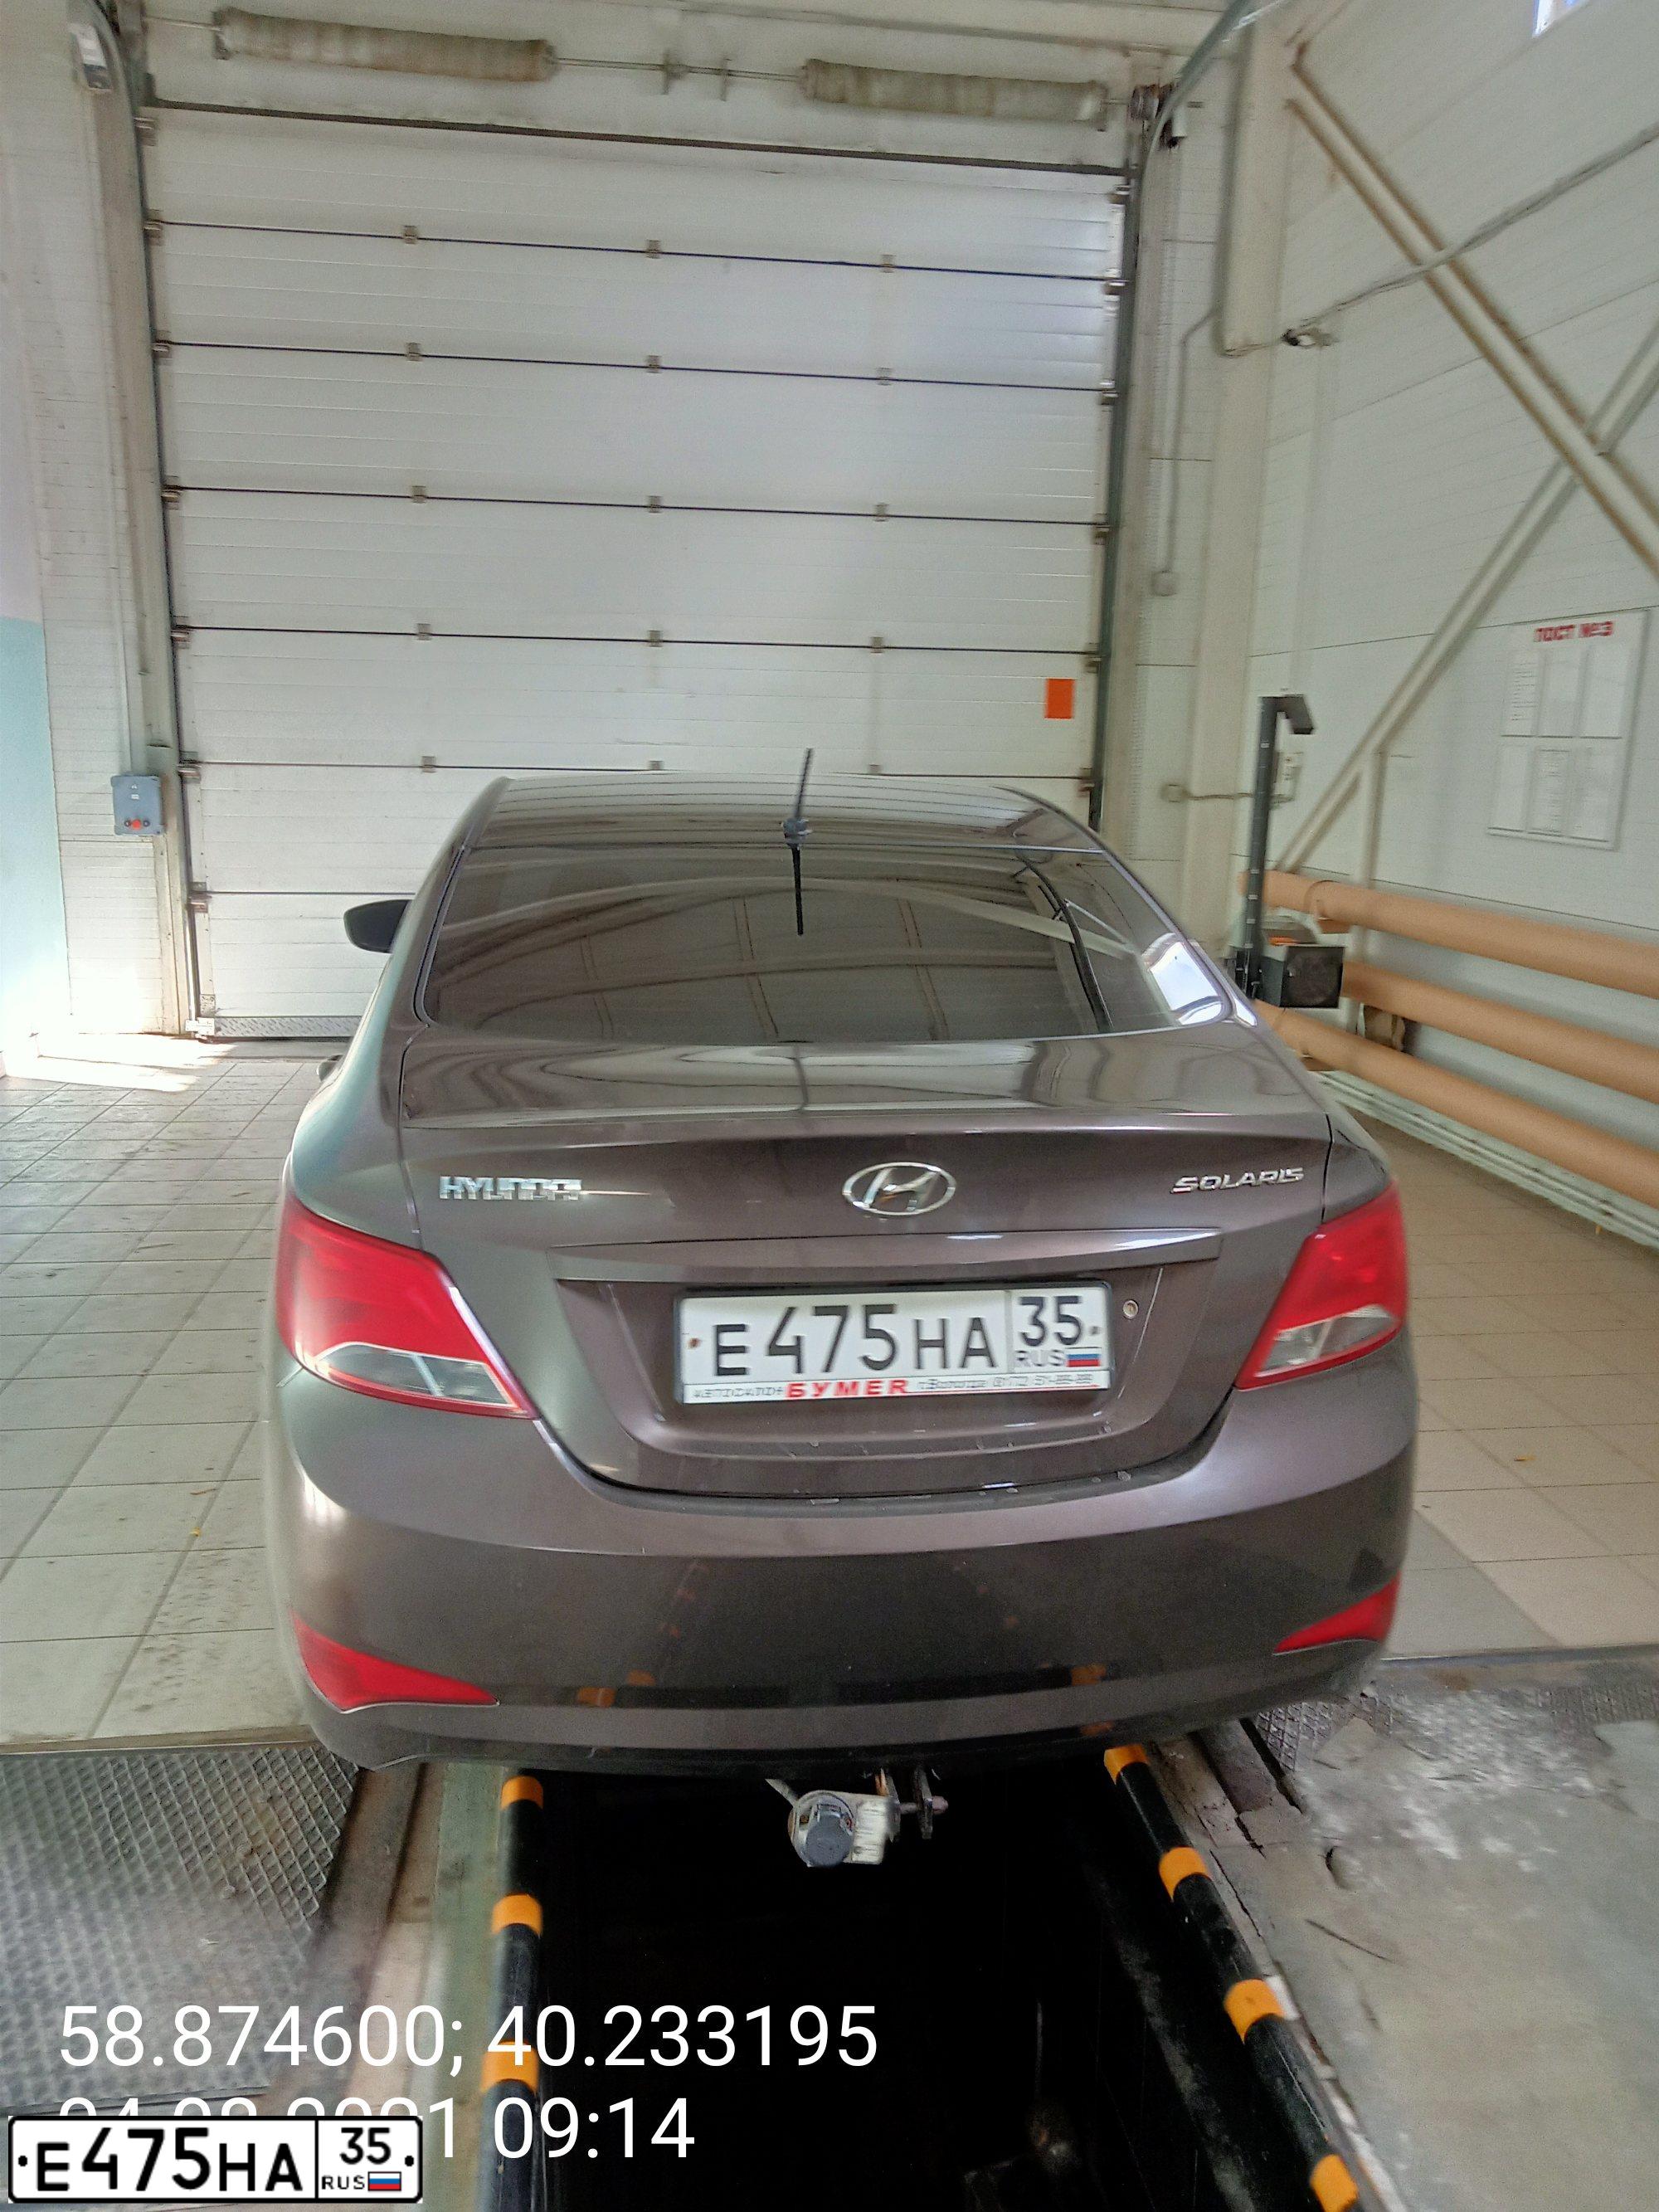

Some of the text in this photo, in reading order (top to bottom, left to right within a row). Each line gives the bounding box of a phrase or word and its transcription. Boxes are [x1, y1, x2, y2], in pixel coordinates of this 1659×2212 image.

[1170, 1167, 1304, 1194] SOLARIS
[1019, 1295, 1082, 1347] 35
[1015, 1349, 1065, 1367] RUS
